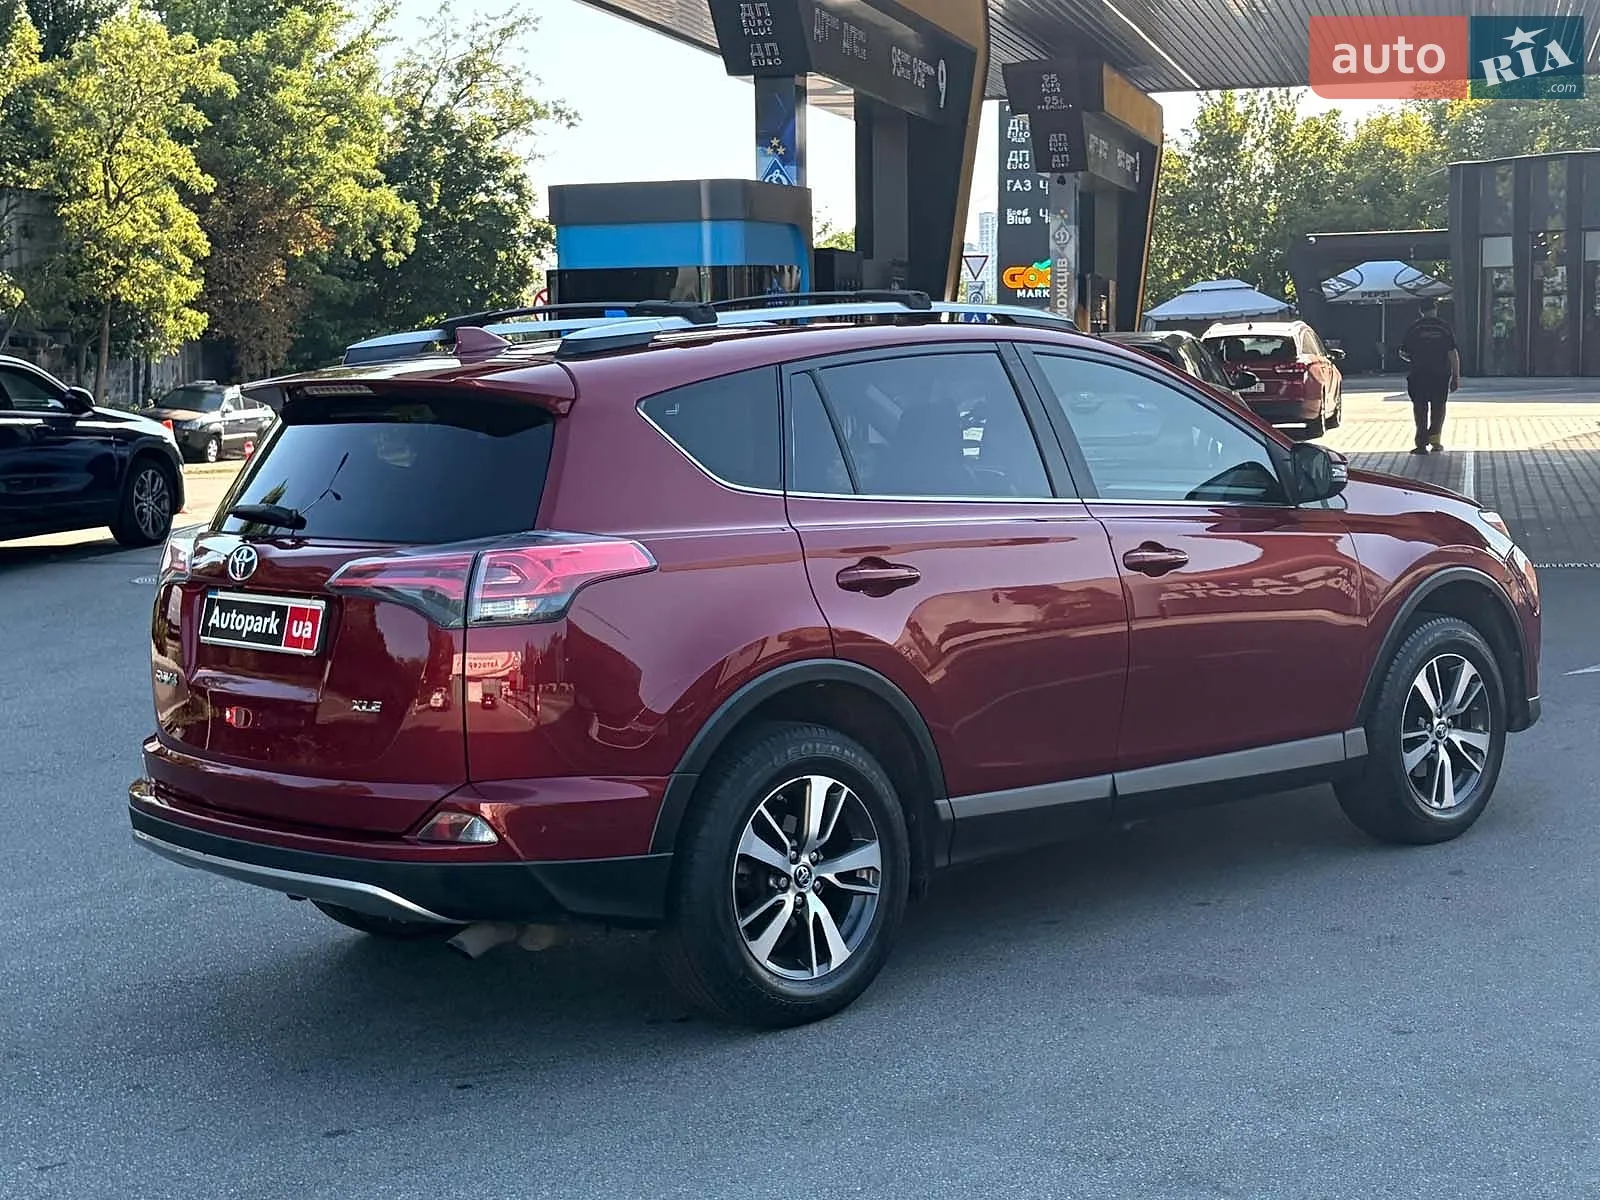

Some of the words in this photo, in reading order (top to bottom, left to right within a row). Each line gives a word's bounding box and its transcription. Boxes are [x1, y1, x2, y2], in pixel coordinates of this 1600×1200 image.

[742, 19, 773, 27] EURO
[752, 58, 782, 66] EURO
[1042, 74, 1058, 83] 95
[1008, 119, 1030, 132] ДП
[1007, 150, 1030, 163] ДП
[1007, 179, 1032, 191] ГАЗ
[1006, 215, 1032, 225] Blue
[208, 605, 280, 636] Autopark
[291, 617, 313, 639] ua
[351, 699, 383, 712] XLE
